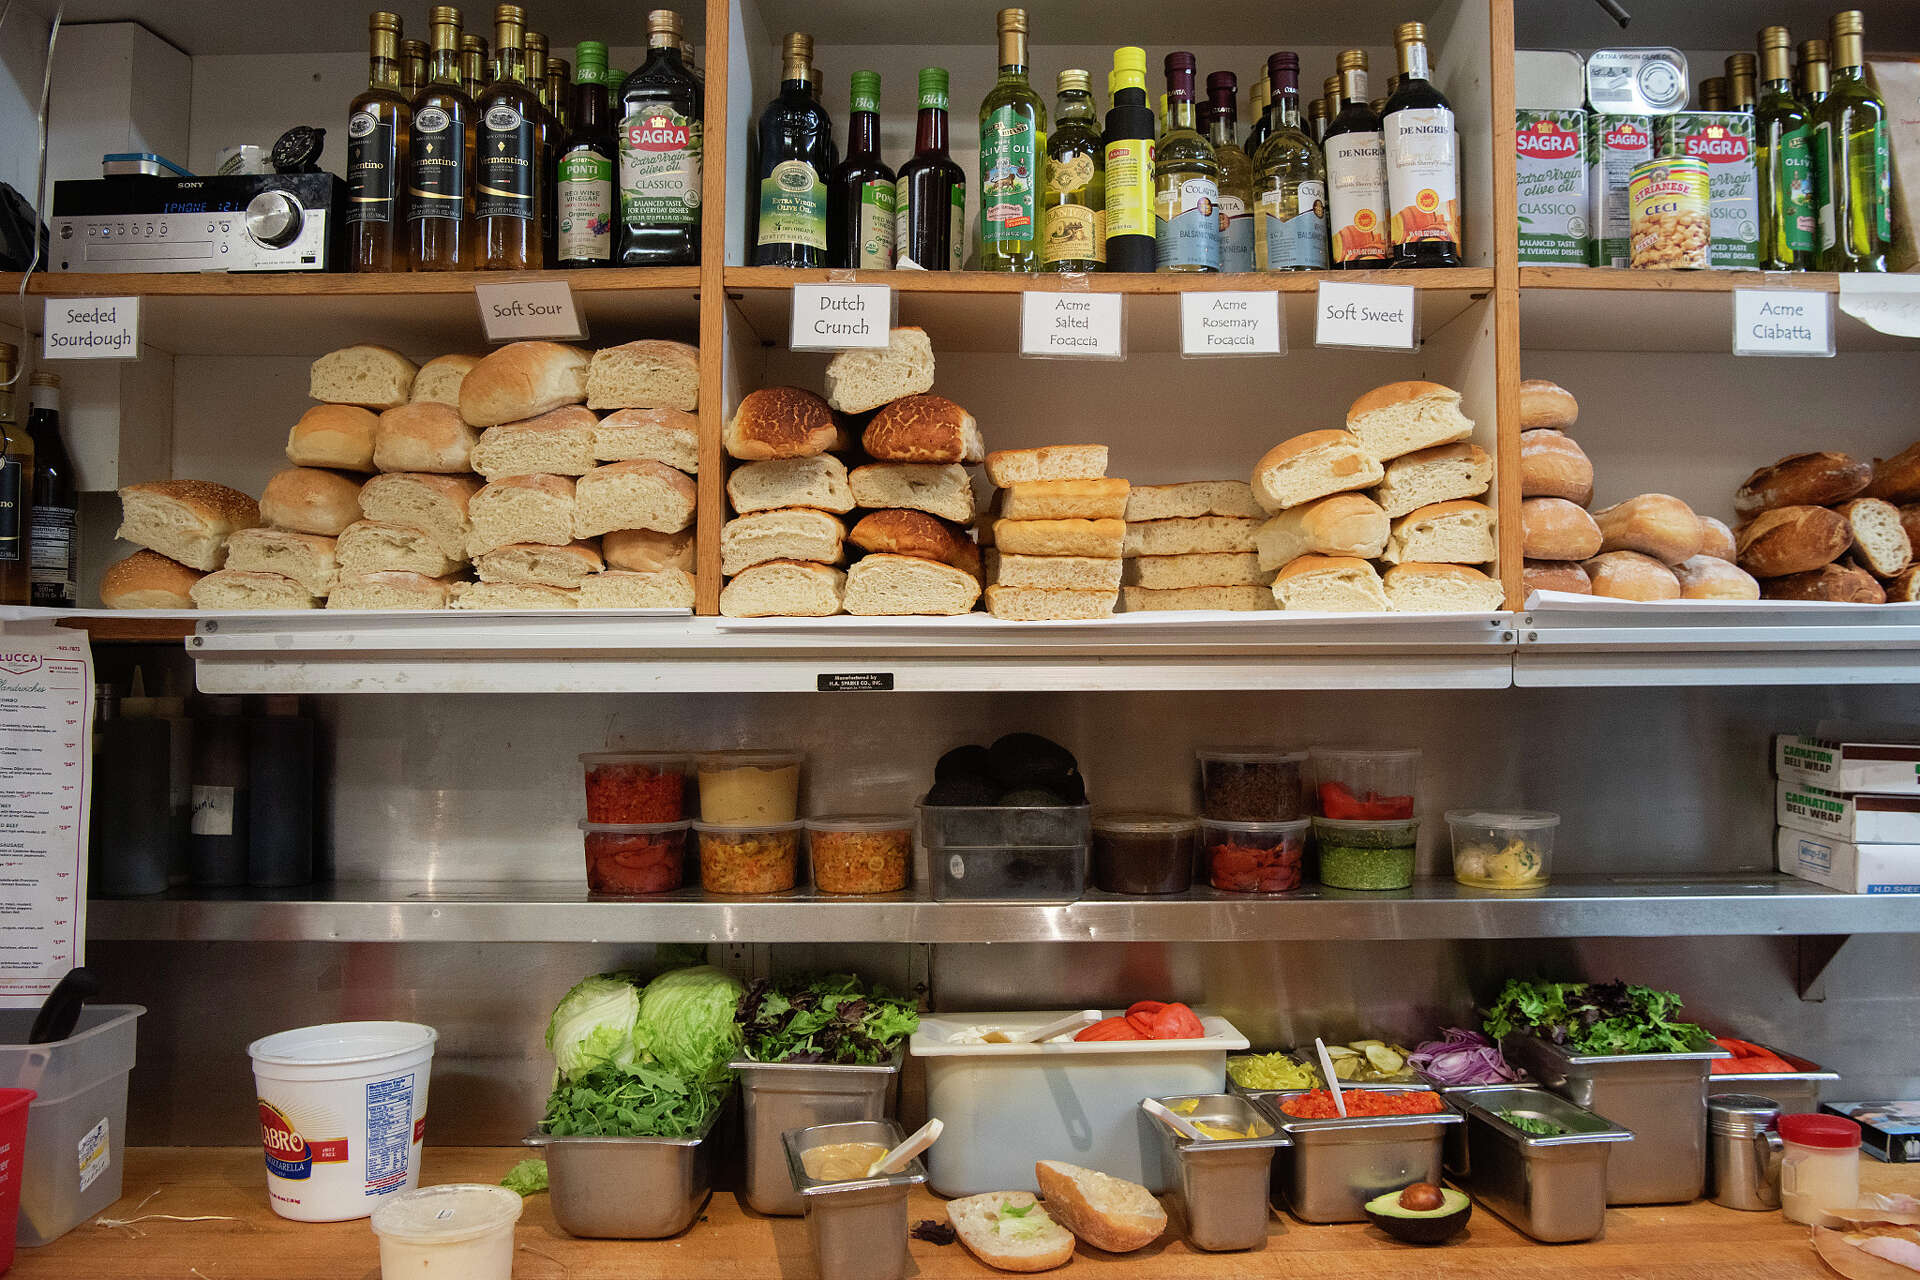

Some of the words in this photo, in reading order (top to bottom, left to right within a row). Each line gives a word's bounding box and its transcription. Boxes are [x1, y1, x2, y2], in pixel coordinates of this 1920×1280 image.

[632, 130, 687, 145] SAGRA
[1400, 127, 1414, 136] DE
[1415, 126, 1449, 134] NIGRIS
[1517, 136, 1576, 151] SAGRA
[1607, 134, 1647, 146] SAGRA
[981, 146, 1009, 158] OLIVE
[1013, 144, 1033, 154] OIL
[1339, 149, 1353, 158] DE
[1353, 148, 1384, 156] NIGR
[1688, 140, 1746, 156] SAGRA
[630, 155, 657, 169] Extra
[657, 151, 686, 168] Virgin
[1786, 158, 1810, 166] OLIV
[567, 165, 598, 174] PONTI
[640, 163, 664, 175] olive
[665, 162, 681, 172] oil
[635, 180, 683, 189] CLASSICO
[1516, 170, 1545, 187] Extra
[1545, 168, 1582, 185] Virgin
[1719, 172, 1752, 189] Virgin
[1524, 183, 1555, 196] olive
[1557, 180, 1575, 193] oil
[1634, 182, 1690, 203] STRIANESE
[1727, 186, 1745, 197] oil
[876, 191, 894, 205] PONT
[1519, 203, 1576, 216] CLASSICO
[1645, 203, 1677, 216] CECI
[1711, 208, 1748, 219] SSICO
[1527, 248, 1560, 256] EVERYDAY
[493, 300, 524, 318] Soft
[527, 302, 563, 316] Sour
[820, 295, 865, 311] Dutch
[1055, 299, 1091, 311] Acme
[1212, 299, 1247, 311] Acme
[1760, 301, 1804, 317] Acme
[67, 307, 117, 324] Seeded
[1326, 303, 1357, 320] Soft
[1360, 307, 1404, 322] Sweet
[814, 318, 869, 335] Crunch
[1055, 316, 1089, 329] Salted
[1202, 317, 1259, 330] Rosemary
[51, 328, 131, 350] Sourdough
[1752, 323, 1812, 341] Ciabatta
[1050, 334, 1098, 347] Focaccia
[1207, 334, 1255, 346] Focaccia
[1783, 745, 1833, 764] CARNATION
[1784, 757, 1801, 768] DELI
[1804, 760, 1832, 773] WRAP
[1785, 791, 1844, 814] CARNATION
[1786, 803, 1806, 815] DELI
[1810, 809, 1842, 824] WRAP
